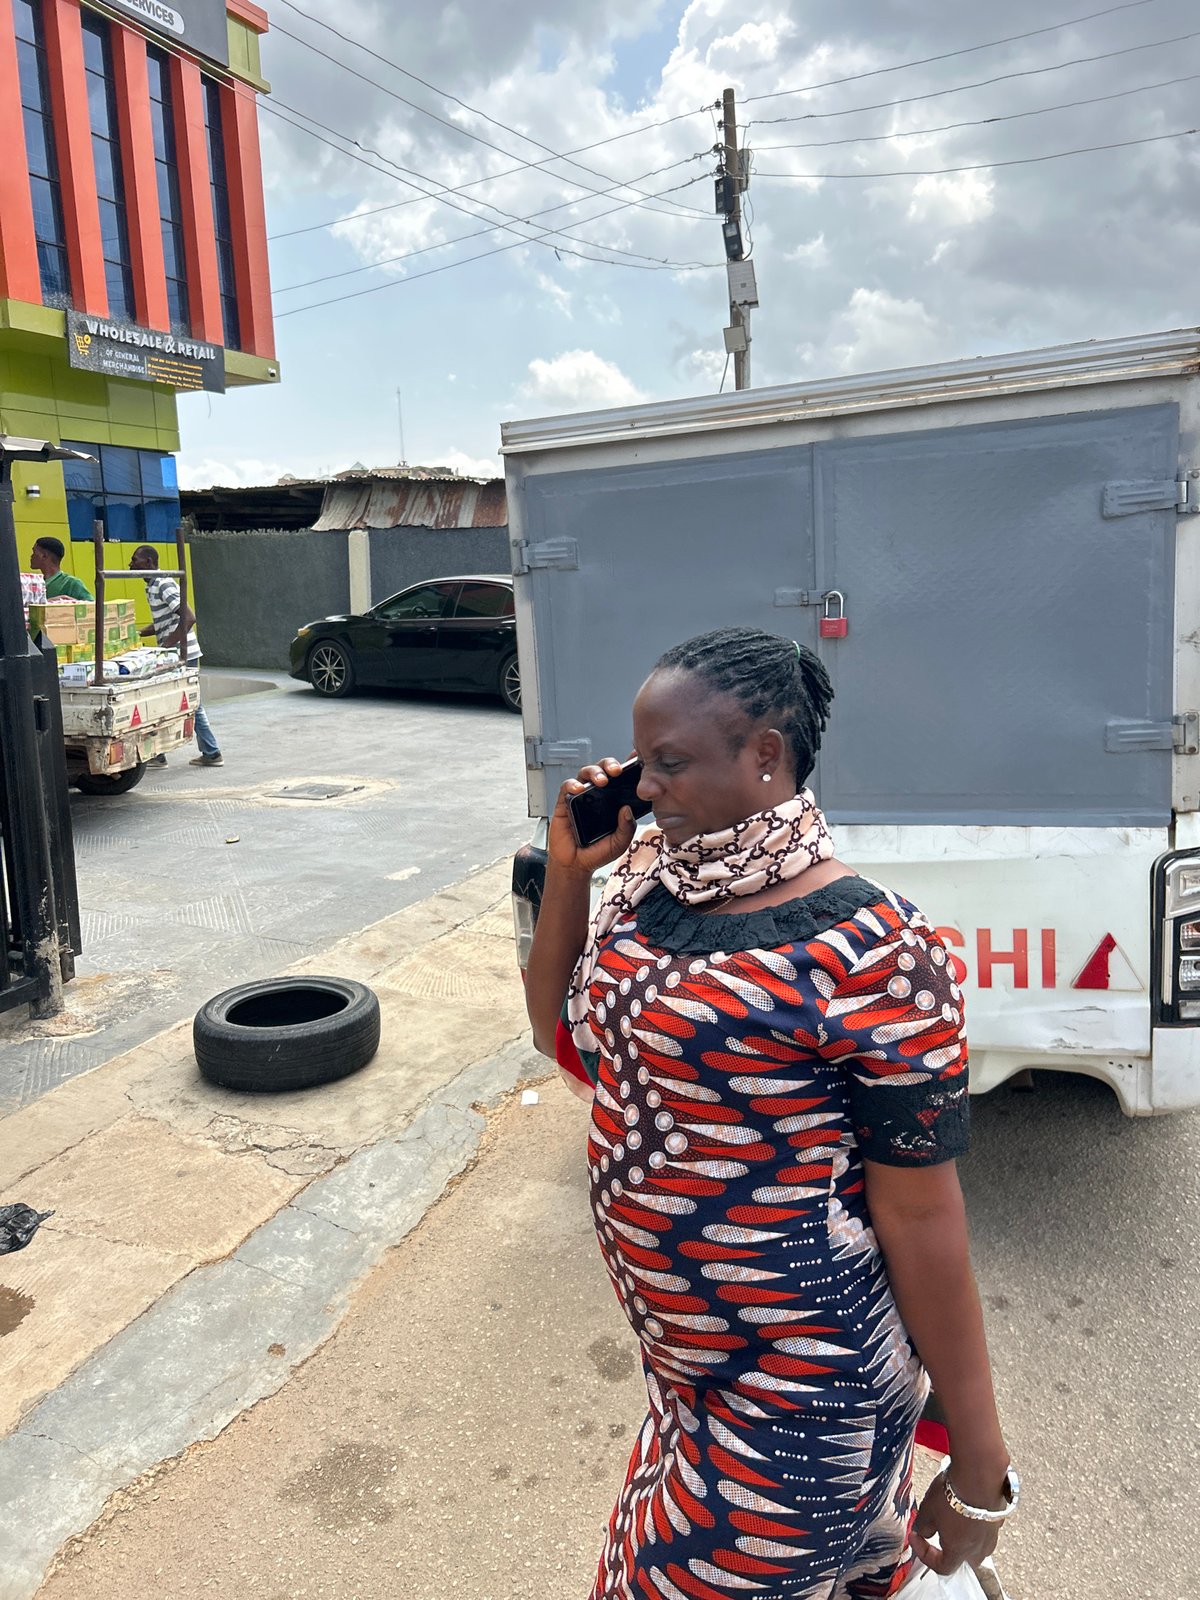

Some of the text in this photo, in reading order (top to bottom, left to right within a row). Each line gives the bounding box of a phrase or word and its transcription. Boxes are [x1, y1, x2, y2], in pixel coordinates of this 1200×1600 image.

[86, 320, 216, 360] WHOLESALE & RETAIL
[105, 349, 139, 363] OF GENERAL
[103, 359, 145, 374] MERCHANDISE
